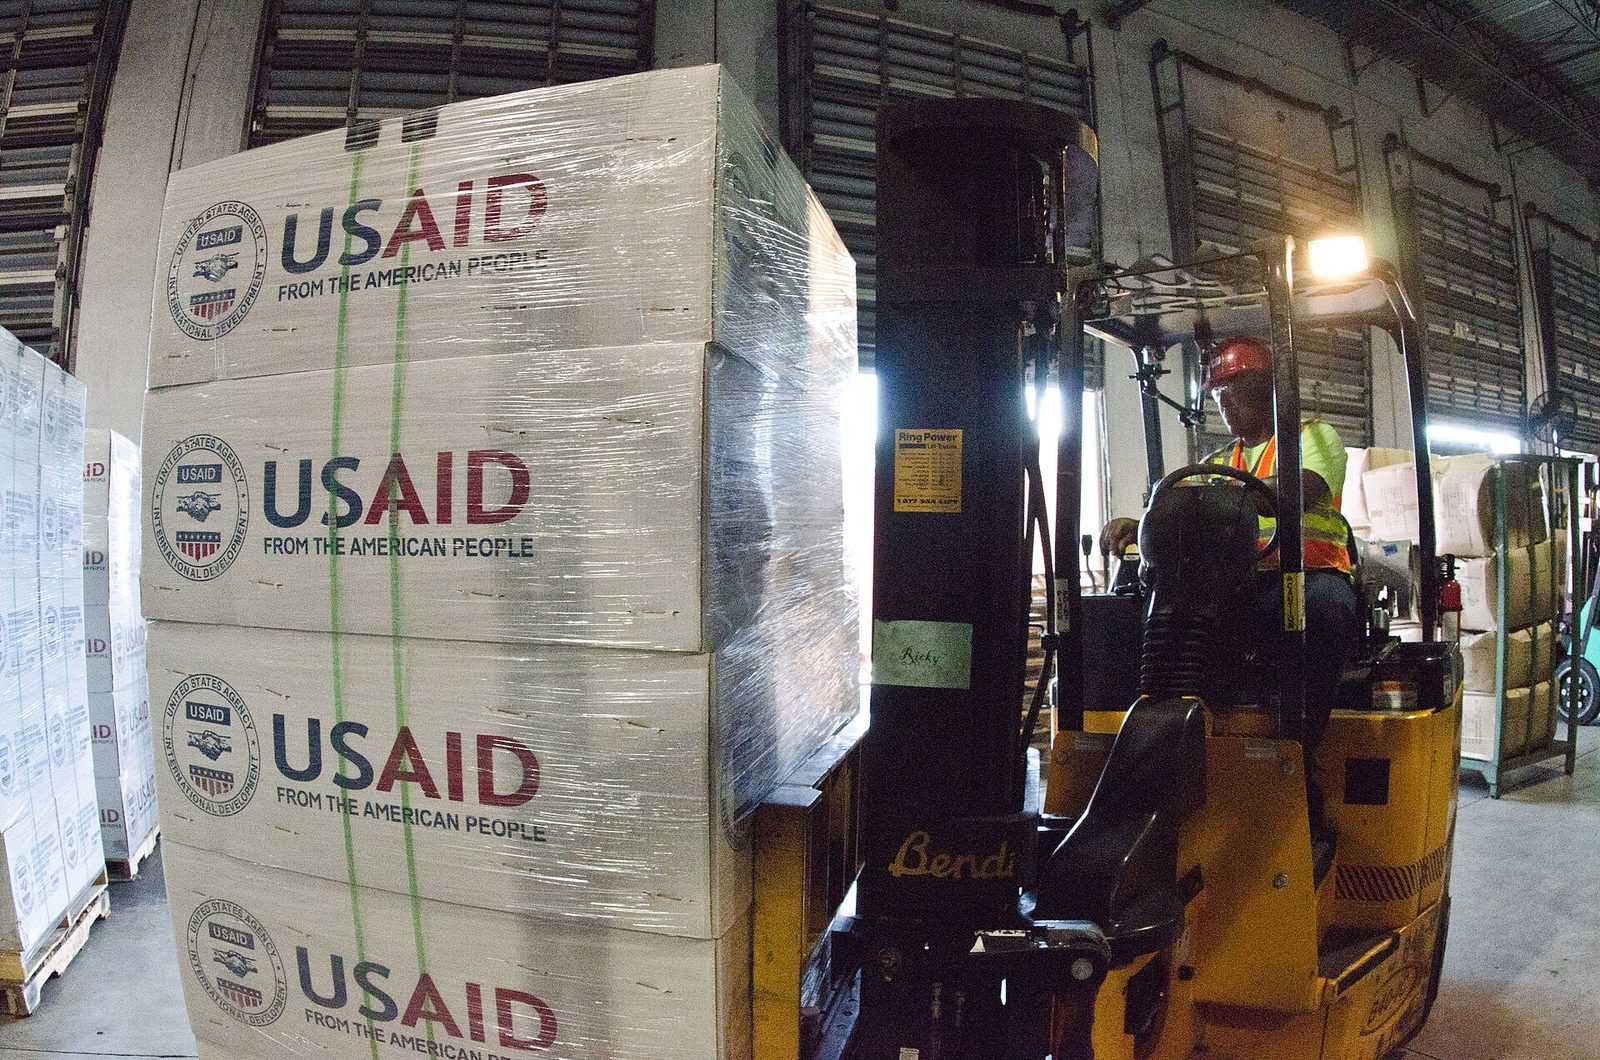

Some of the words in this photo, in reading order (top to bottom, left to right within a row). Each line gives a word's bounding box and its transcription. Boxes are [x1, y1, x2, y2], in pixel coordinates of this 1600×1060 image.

[176, 218, 204, 256] UNITED
[206, 204, 239, 220] STATES
[238, 206, 264, 239] AGENCY
[202, 230, 236, 246] USAID
[281, 173, 548, 275] USAID
[278, 279, 323, 302] FROM
[329, 273, 361, 294] THE
[364, 260, 461, 290] AMERICAN
[467, 250, 548, 277] PEOPLE
[169, 276, 212, 338] INTERNATIONAL
[158, 447, 183, 486] UNITED
[184, 437, 216, 451] STATES
[216, 443, 244, 483] AGENCY
[899, 432, 923, 442] Ring
[924, 432, 957, 442] Power
[182, 468, 216, 481] USAID
[263, 450, 531, 528] USAID
[154, 506, 202, 579] INTERNATIONAL
[203, 508, 247, 579] DEVELOPMENT
[263, 537, 309, 556] FROM
[313, 537, 346, 557] THE
[349, 537, 447, 558] AMERICAN
[453, 538, 534, 559] PEOPLE
[166, 684, 190, 718] UNITED
[190, 677, 222, 692] STATES
[223, 687, 253, 731] AGENCY
[190, 705, 224, 722] USAID
[165, 736, 216, 814] INTERNATIONAL
[219, 754, 259, 815] DEVELOPMENT
[272, 713, 541, 808] USAID
[277, 786, 322, 809] FROM
[325, 794, 359, 816] THE
[363, 802, 460, 831] AMERICAN
[466, 815, 548, 843] PEOPLE
[888, 831, 1015, 878] Bendi
[190, 906, 211, 934] UNITED
[212, 901, 243, 919] STATES
[244, 915, 277, 957] AGENCY
[213, 928, 248, 946] USAID
[189, 949, 246, 1023] INTERNATIONAL
[248, 980, 285, 1024] DEVELOPMENT
[296, 946, 558, 1051] USAID
[305, 1008, 350, 1034] FROM
[352, 1022, 387, 1043] THE
